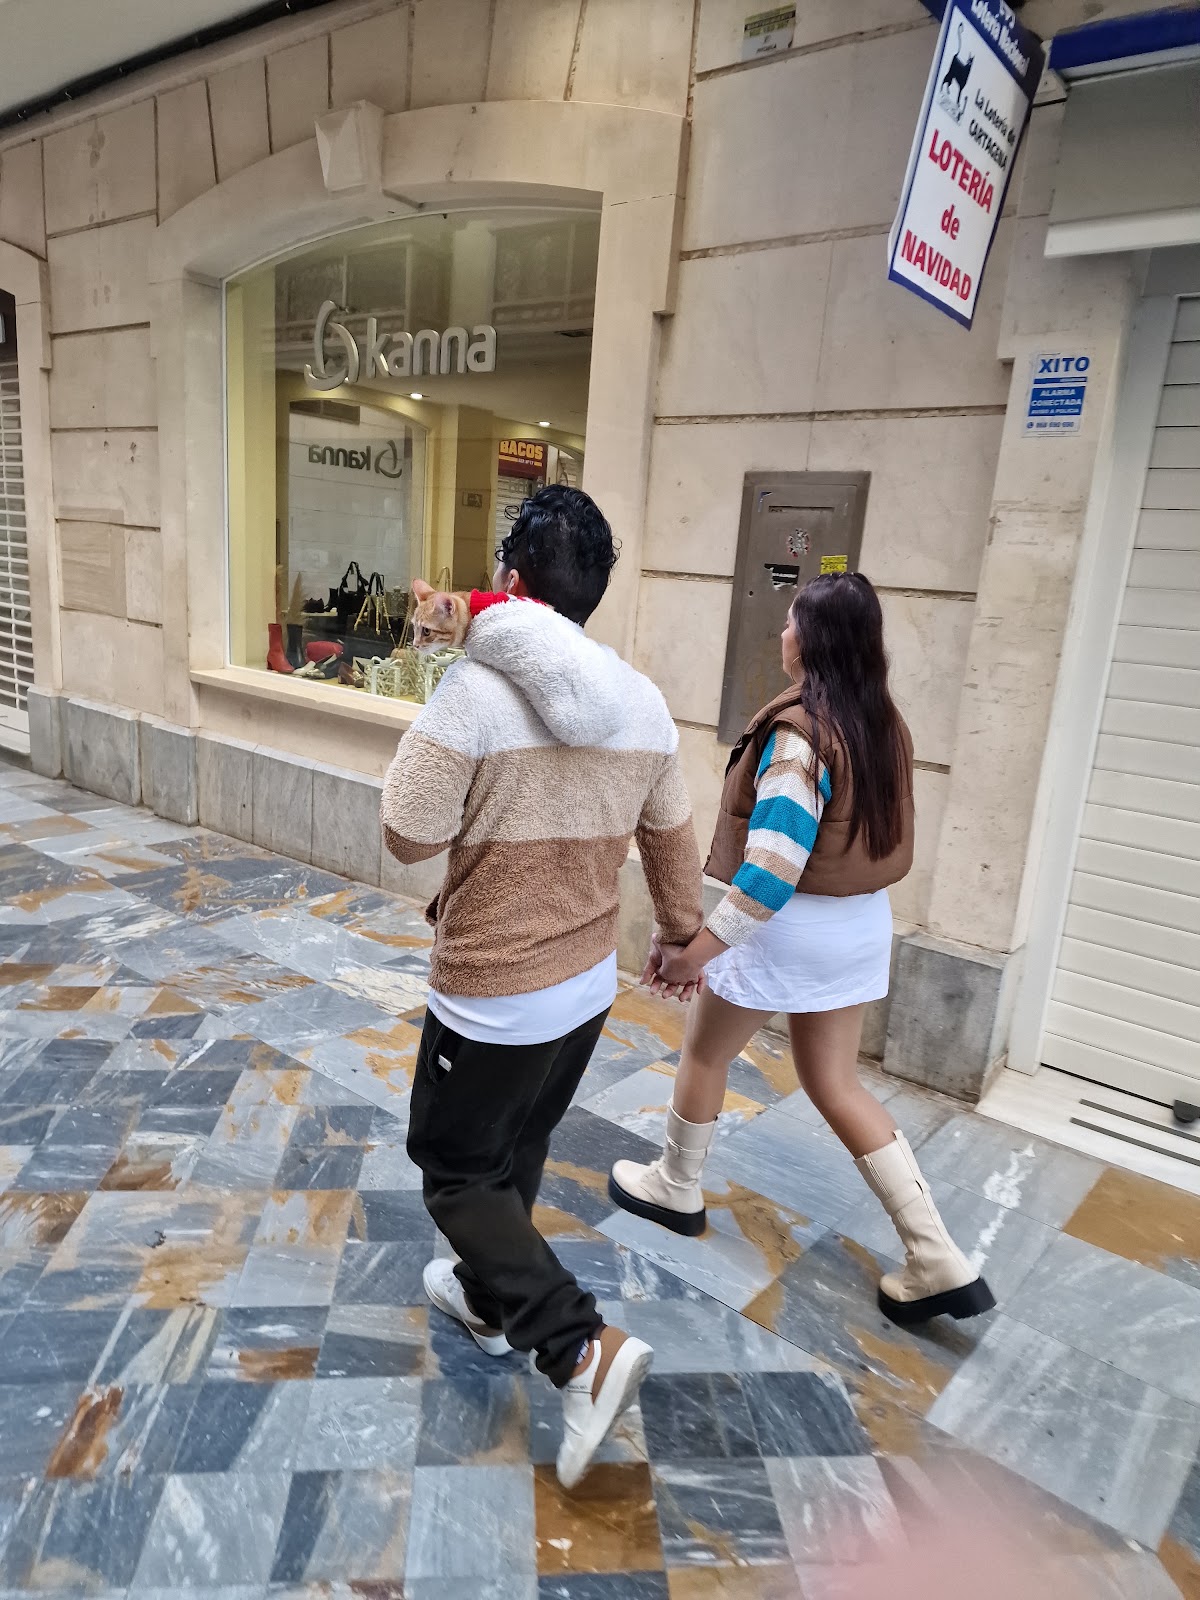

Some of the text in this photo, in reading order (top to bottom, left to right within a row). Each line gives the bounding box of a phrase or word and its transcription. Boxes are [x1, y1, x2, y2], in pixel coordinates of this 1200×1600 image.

[928, 128, 995, 214] LOTERÍA
[940, 204, 960, 241] de
[901, 229, 972, 301] NAVIDAD
[366, 317, 498, 379] kanna
[1038, 356, 1090, 374] XITO
